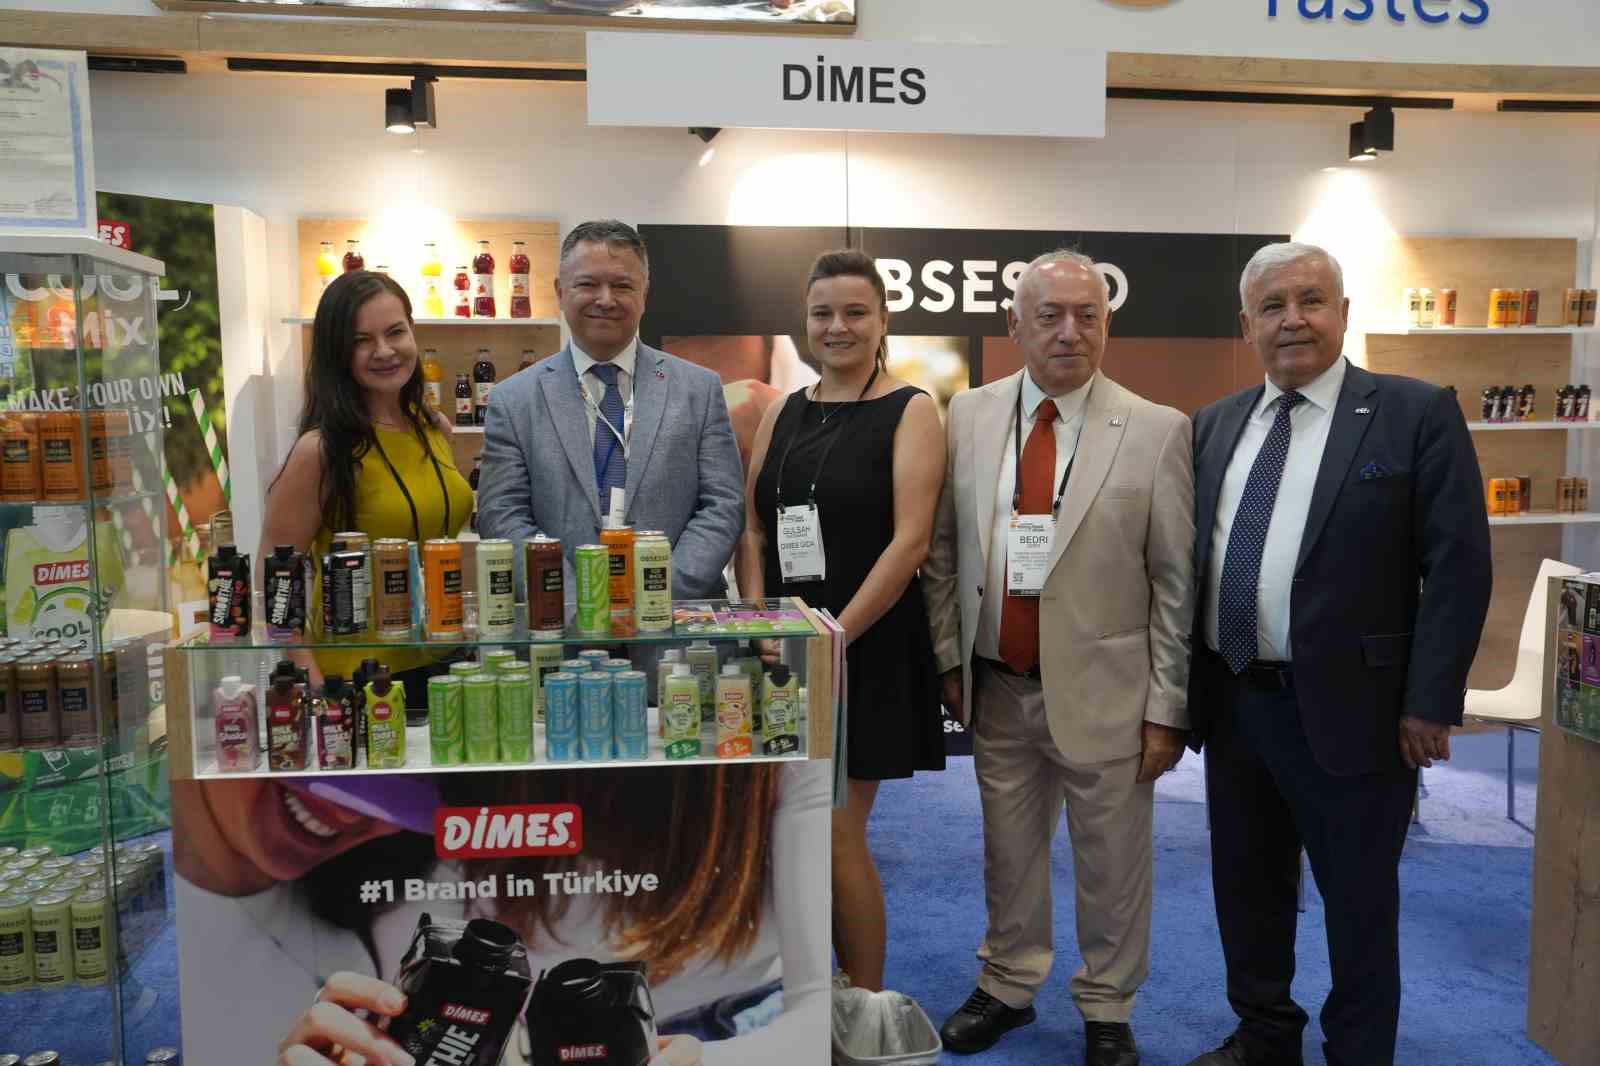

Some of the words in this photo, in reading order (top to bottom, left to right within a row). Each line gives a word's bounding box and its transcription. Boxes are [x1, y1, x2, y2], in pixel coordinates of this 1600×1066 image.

[783, 55, 926, 105] DİMES
[7, 387, 74, 412] MAKE
[139, 372, 186, 400] OWN
[1019, 536, 1048, 544] BEDRI
[443, 807, 573, 850] DİMES
[359, 879, 394, 903] #1
[404, 875, 498, 901] Brand
[507, 874, 535, 897] in
[543, 869, 659, 896] Türkiye
